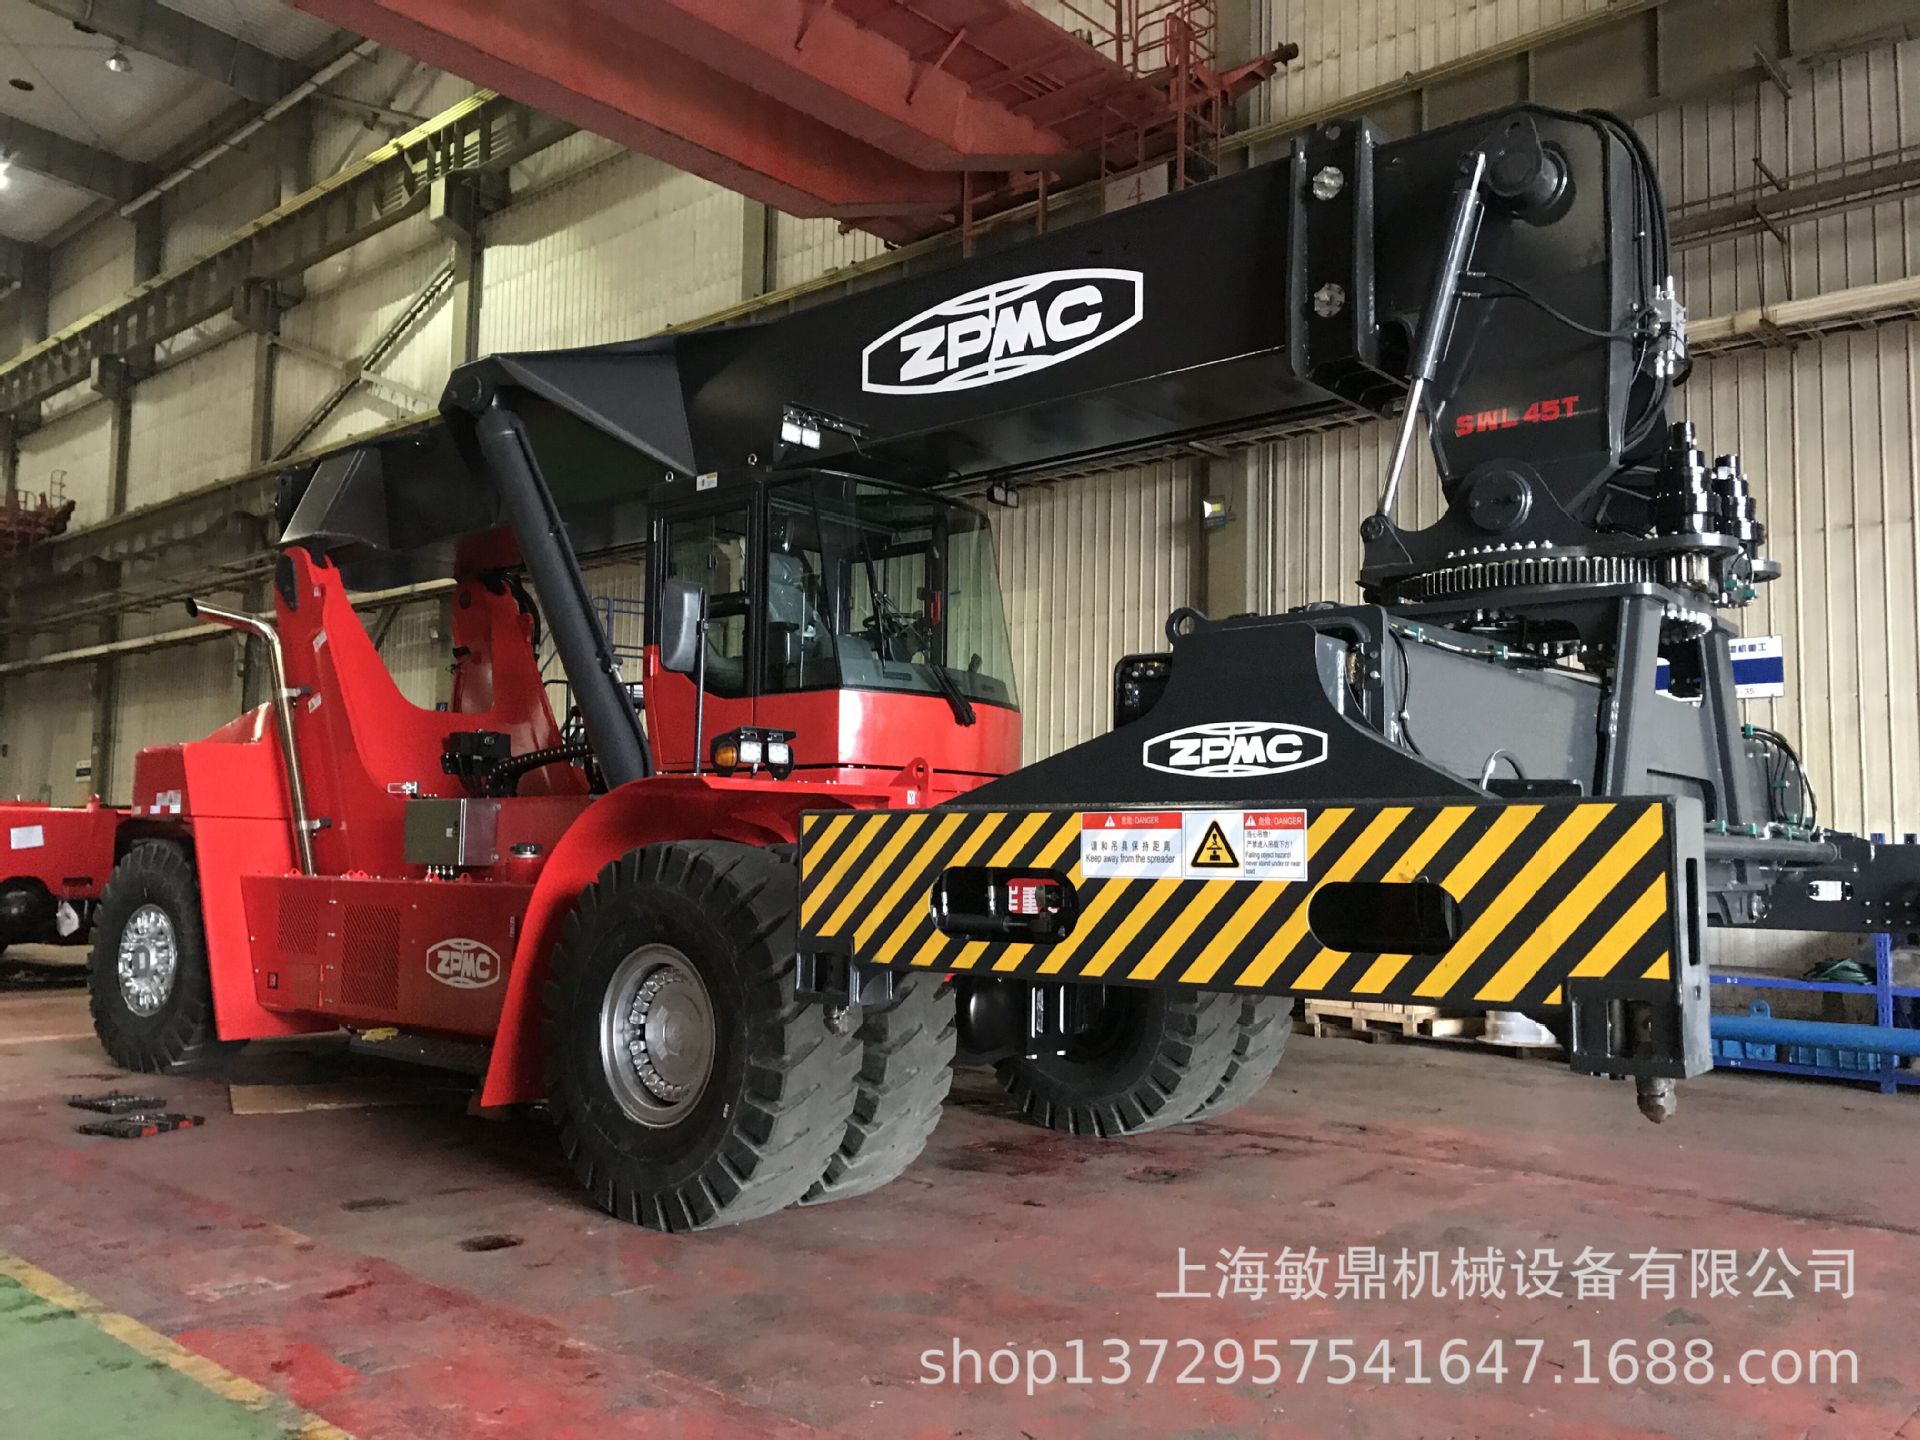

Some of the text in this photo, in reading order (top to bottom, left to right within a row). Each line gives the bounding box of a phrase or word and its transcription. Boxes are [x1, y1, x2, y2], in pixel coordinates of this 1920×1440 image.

[900, 285, 1103, 382] ZPMC
[1455, 395, 1579, 437] SWL 45T
[1168, 734, 1304, 767] ZPMC
[1134, 816, 1159, 825] DANGER
[1274, 816, 1302, 825] DANGER
[1085, 854, 1175, 864] Keep away from the spreader
[1246, 851, 1260, 860] Falling
[437, 950, 491, 979] ZPMC
